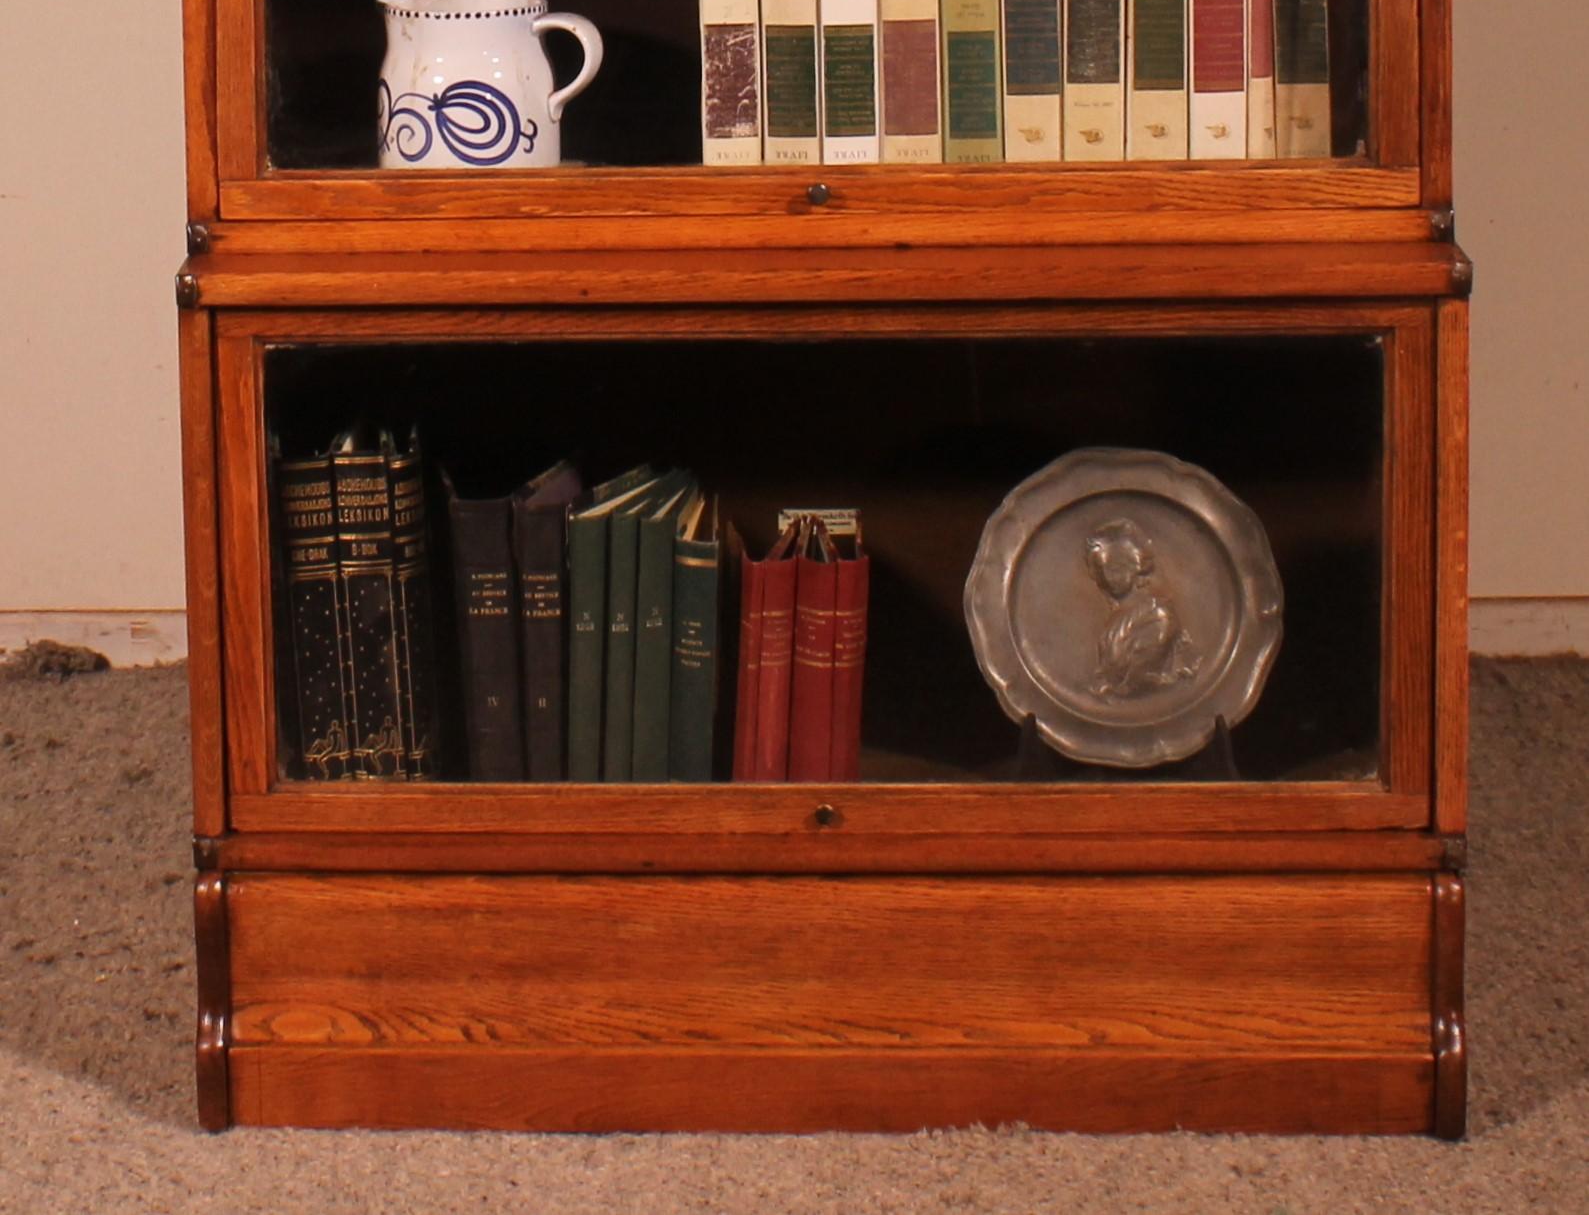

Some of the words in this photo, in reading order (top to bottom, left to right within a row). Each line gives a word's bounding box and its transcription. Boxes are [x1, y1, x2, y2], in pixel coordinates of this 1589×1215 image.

[775, 151, 808, 161] LIVRE
[834, 150, 867, 160] LIVRE
[896, 148, 930, 158] LIVRE
[339, 506, 389, 523] LEKSIKON
[481, 606, 508, 615] FRANCE
[532, 609, 561, 617] FRANCE
